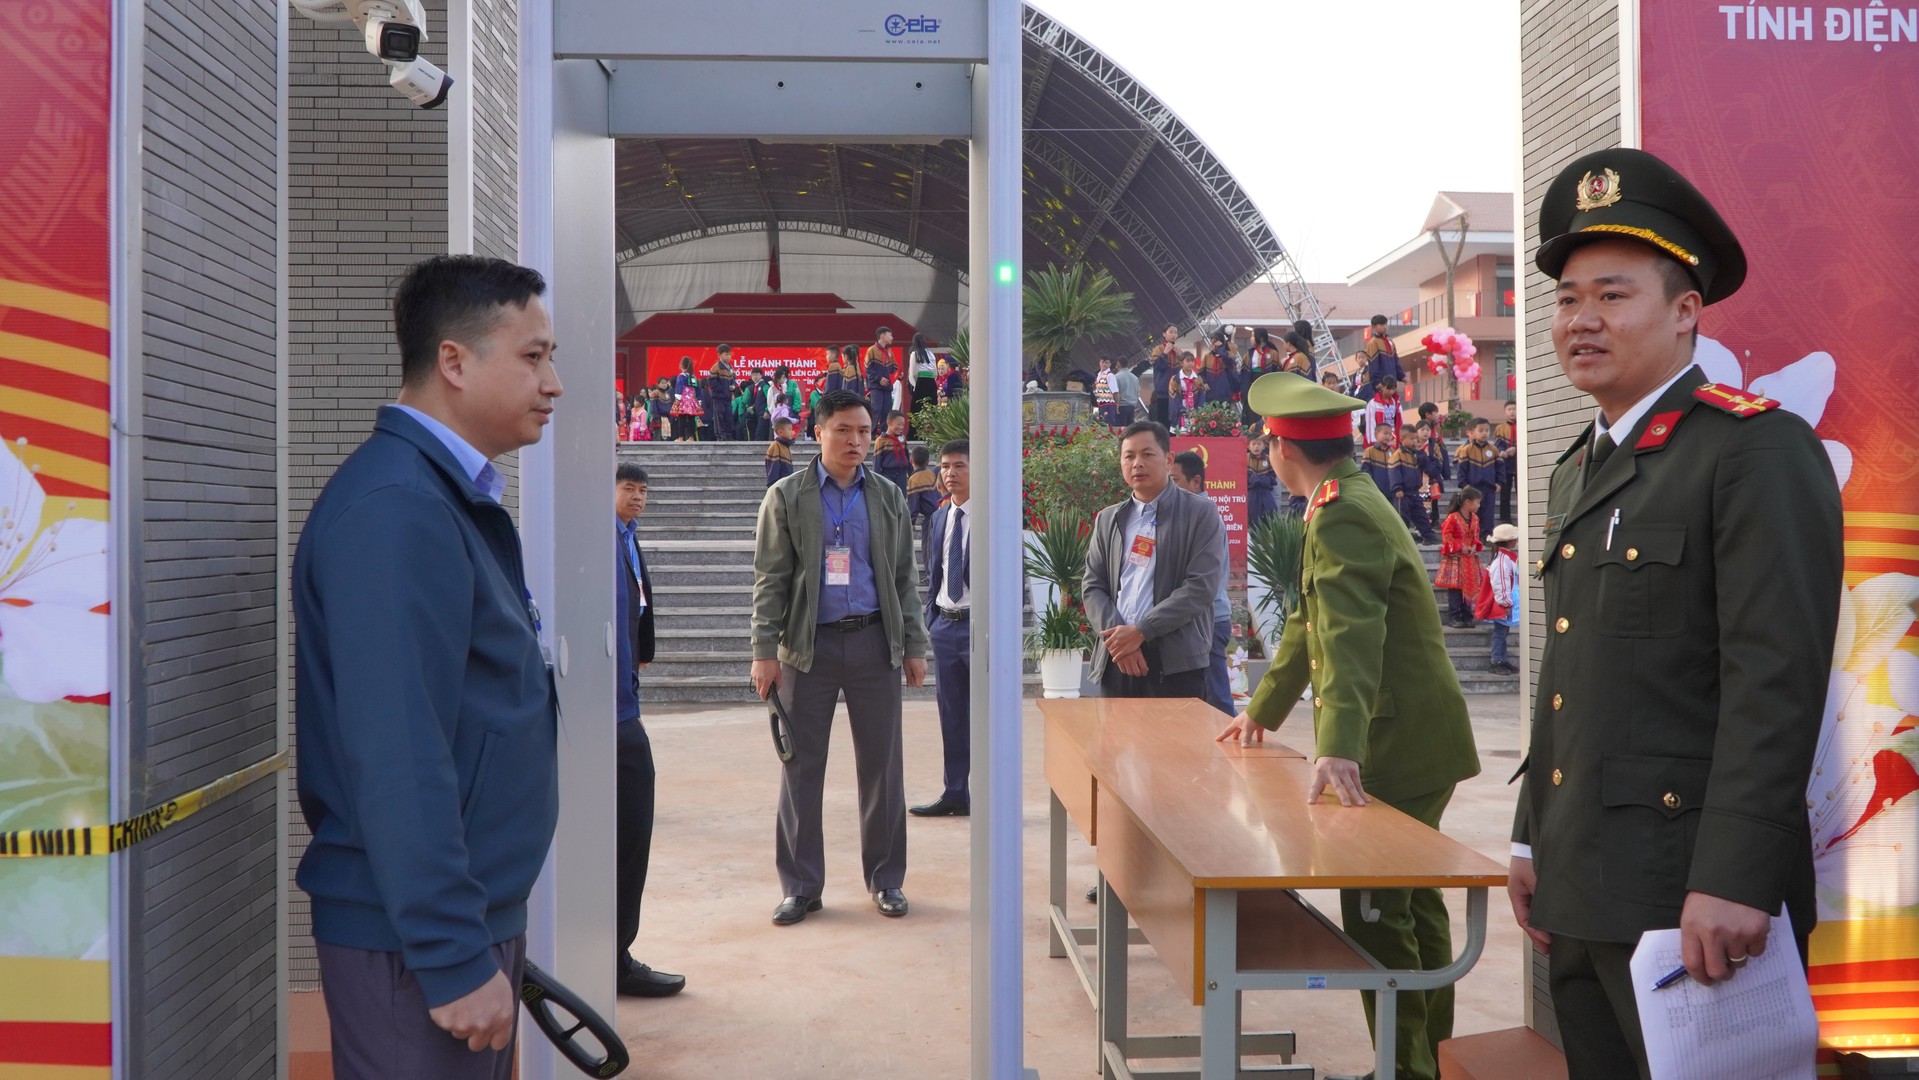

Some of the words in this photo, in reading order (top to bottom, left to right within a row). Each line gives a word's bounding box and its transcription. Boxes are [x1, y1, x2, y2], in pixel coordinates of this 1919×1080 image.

[1824, 0, 1918, 53] ĐIỆN
[734, 355, 746, 368] LỄ
[748, 358, 781, 368] KHÁNH
[783, 357, 817, 368] THÀNH
[791, 369, 806, 377] LIÊN
[807, 368, 821, 377] CẤP
[1205, 480, 1236, 489] THÀNH
[1218, 495, 1231, 504] NỘI
[1232, 495, 1247, 503] TRÚ
